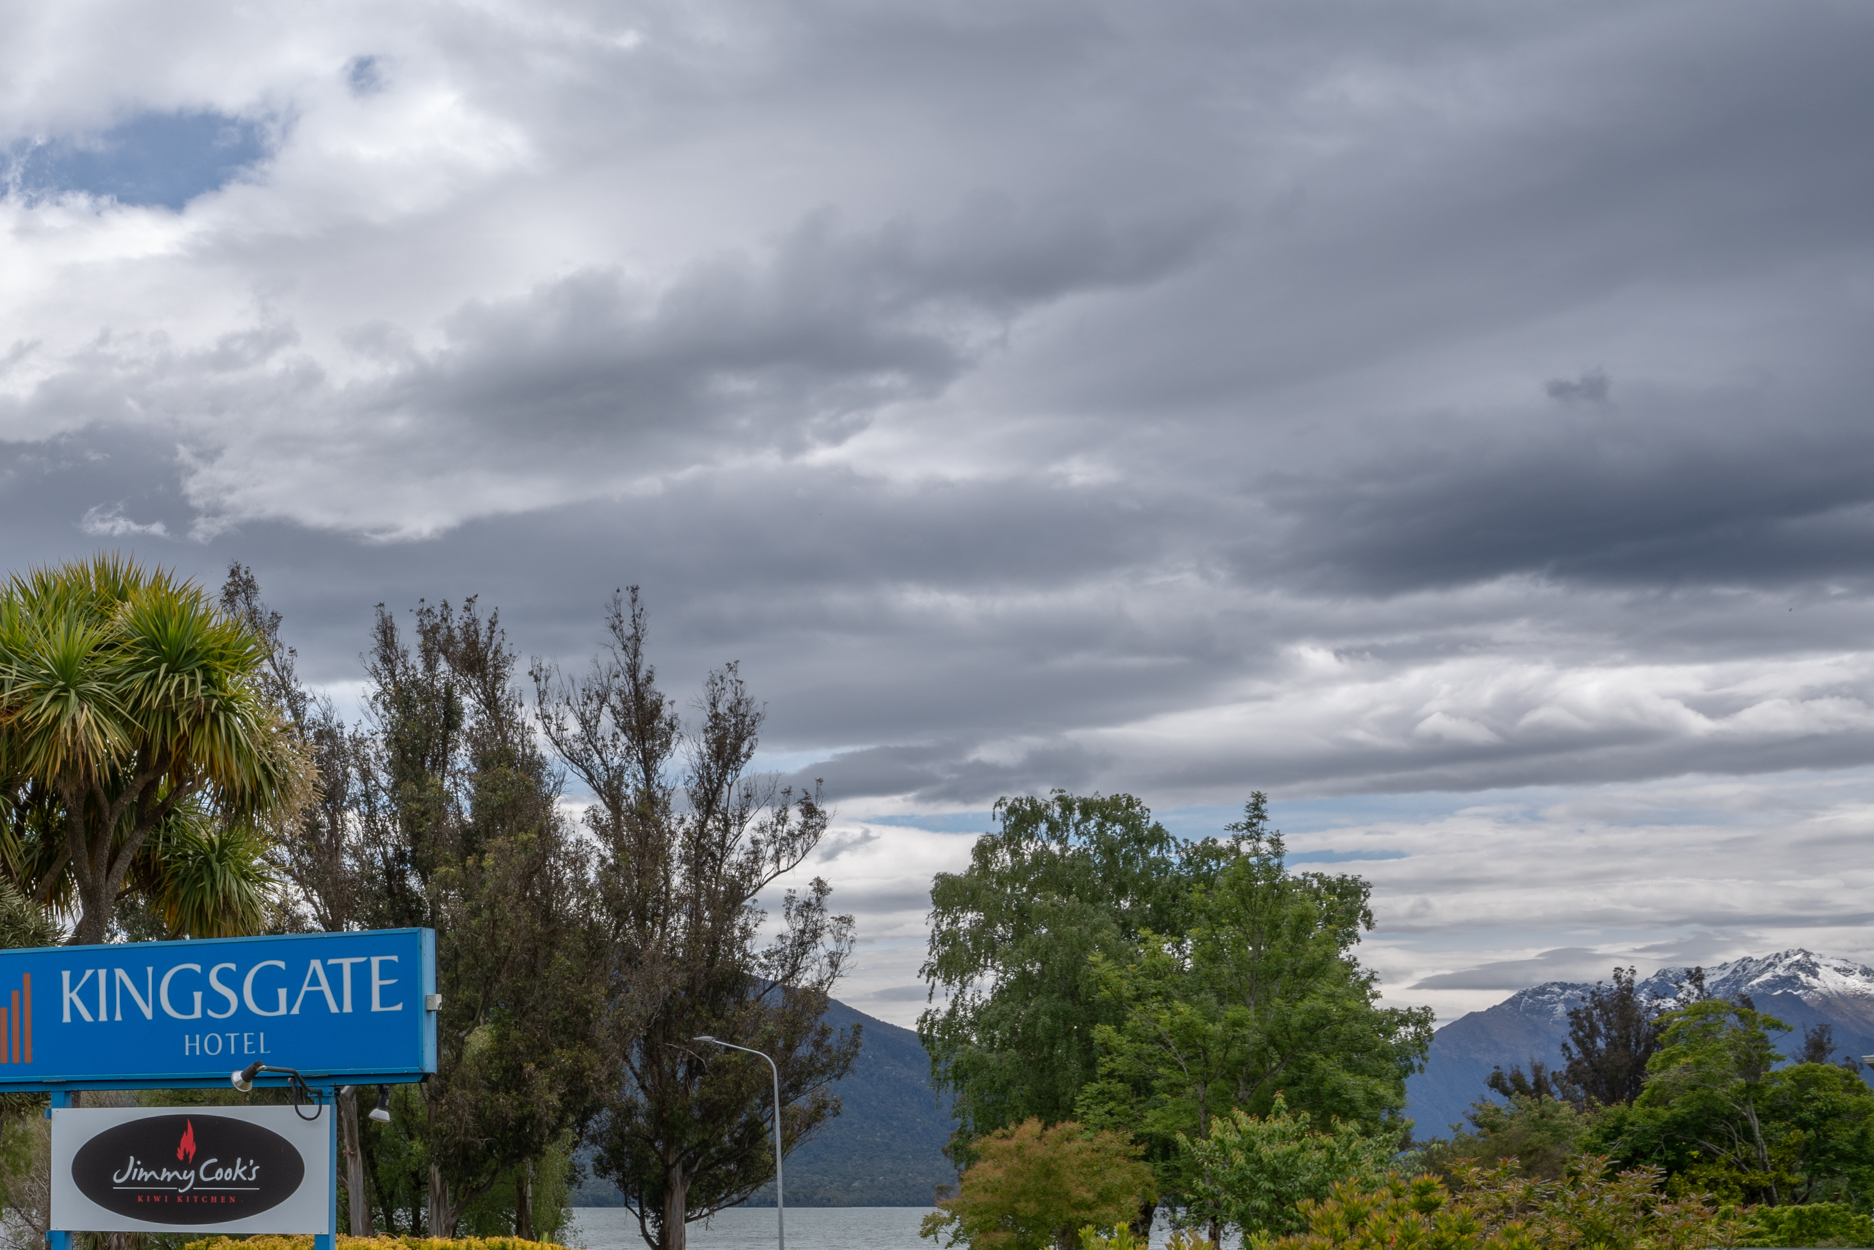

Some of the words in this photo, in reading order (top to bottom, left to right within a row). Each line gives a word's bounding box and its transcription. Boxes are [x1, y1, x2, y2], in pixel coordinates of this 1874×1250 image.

[60, 954, 404, 1023] KINGSGATE
[184, 1031, 271, 1056] HOTEL
[112, 1155, 196, 1193] Jimmy
[199, 1157, 261, 1182] Cook's
[137, 1195, 168, 1203] KIWI
[177, 1195, 236, 1203] KITCHEN
